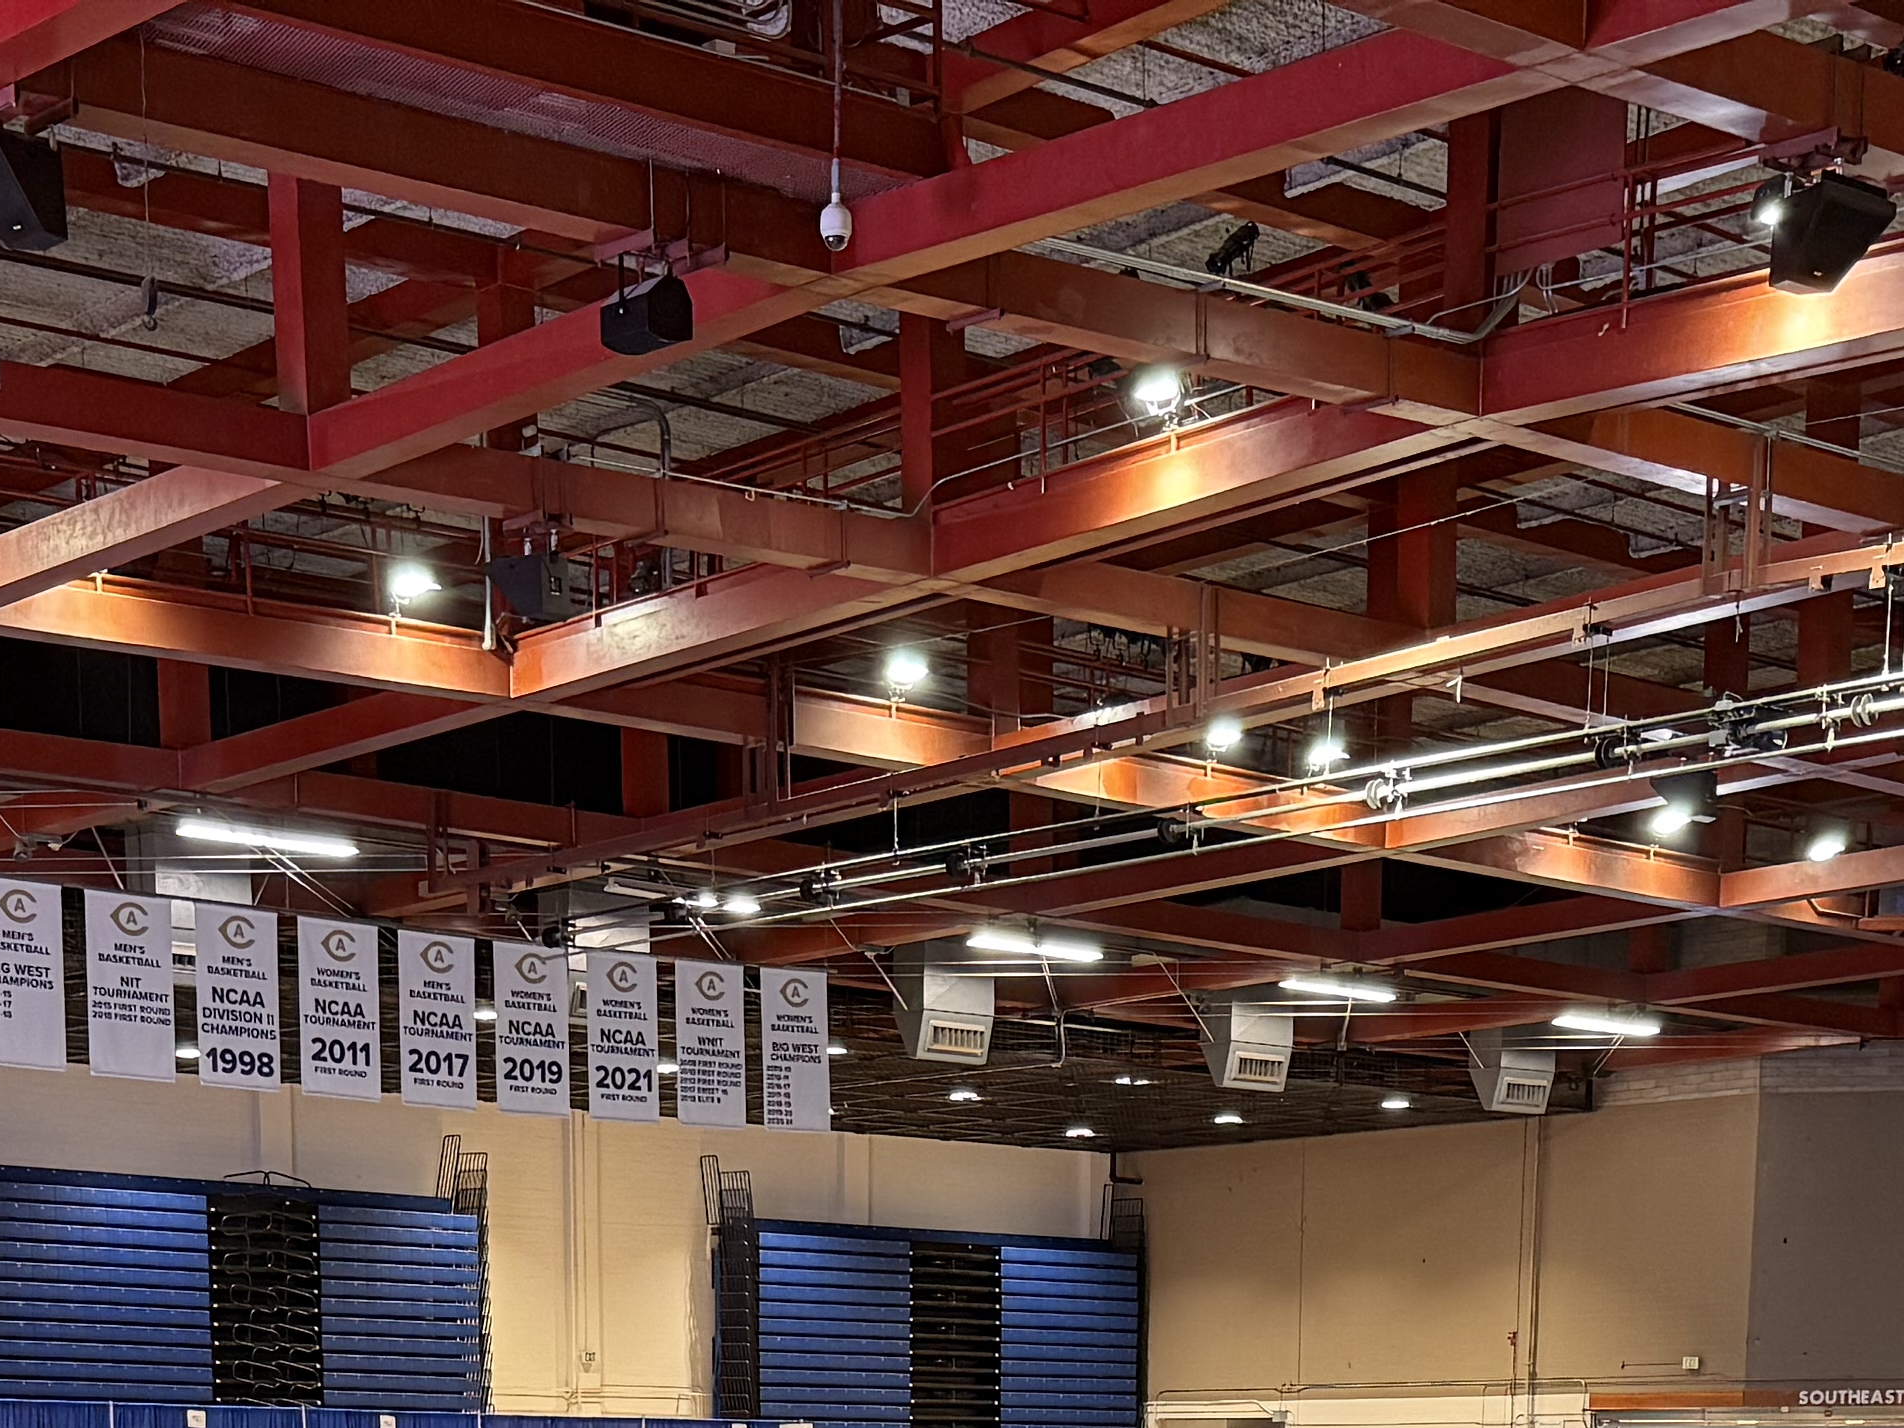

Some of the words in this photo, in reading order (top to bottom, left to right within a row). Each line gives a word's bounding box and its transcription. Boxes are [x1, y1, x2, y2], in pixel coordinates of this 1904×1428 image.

[2, 930, 34, 942] MEN'S
[114, 943, 146, 954] MEN'S
[98, 952, 161, 968] BASKETBALL
[222, 956, 252, 966] MEN'S
[14, 964, 50, 978] WEST
[207, 965, 268, 980] BASKETBALL
[316, 967, 360, 980] WOMEN'S
[120, 976, 142, 988] NIT
[311, 978, 368, 992] BASKETBALL
[93, 986, 170, 1003] TOURNAMENT
[212, 986, 265, 1008] NCAA
[410, 989, 466, 1004] BASKETBALL
[511, 990, 552, 1002] WOMEN'S
[314, 998, 365, 1018] NCAA
[505, 1000, 557, 1013] BASKETBALL
[602, 998, 642, 1010] WOMEN'S
[202, 1006, 263, 1024] DIVISION
[304, 1014, 376, 1031] TOURNAMENT
[413, 1010, 463, 1030] NCAA
[597, 1009, 648, 1021] BASKETBALL
[201, 1022, 276, 1040] CHAMPIONS
[403, 1026, 474, 1042] TOURNAMENT
[508, 1020, 556, 1038] NCAA
[499, 1035, 566, 1050] TOURNAMENT
[600, 1028, 646, 1046] NCAA
[311, 1038, 370, 1067] 2011
[590, 1044, 656, 1058] TOURNAMENT
[680, 1046, 740, 1058] TOURNAMENT
[792, 1043, 818, 1054] WEST
[206, 1048, 274, 1078] 1998
[408, 1048, 470, 1078] 2017
[502, 1056, 563, 1084] 2019
[596, 1065, 652, 1092] 2021
